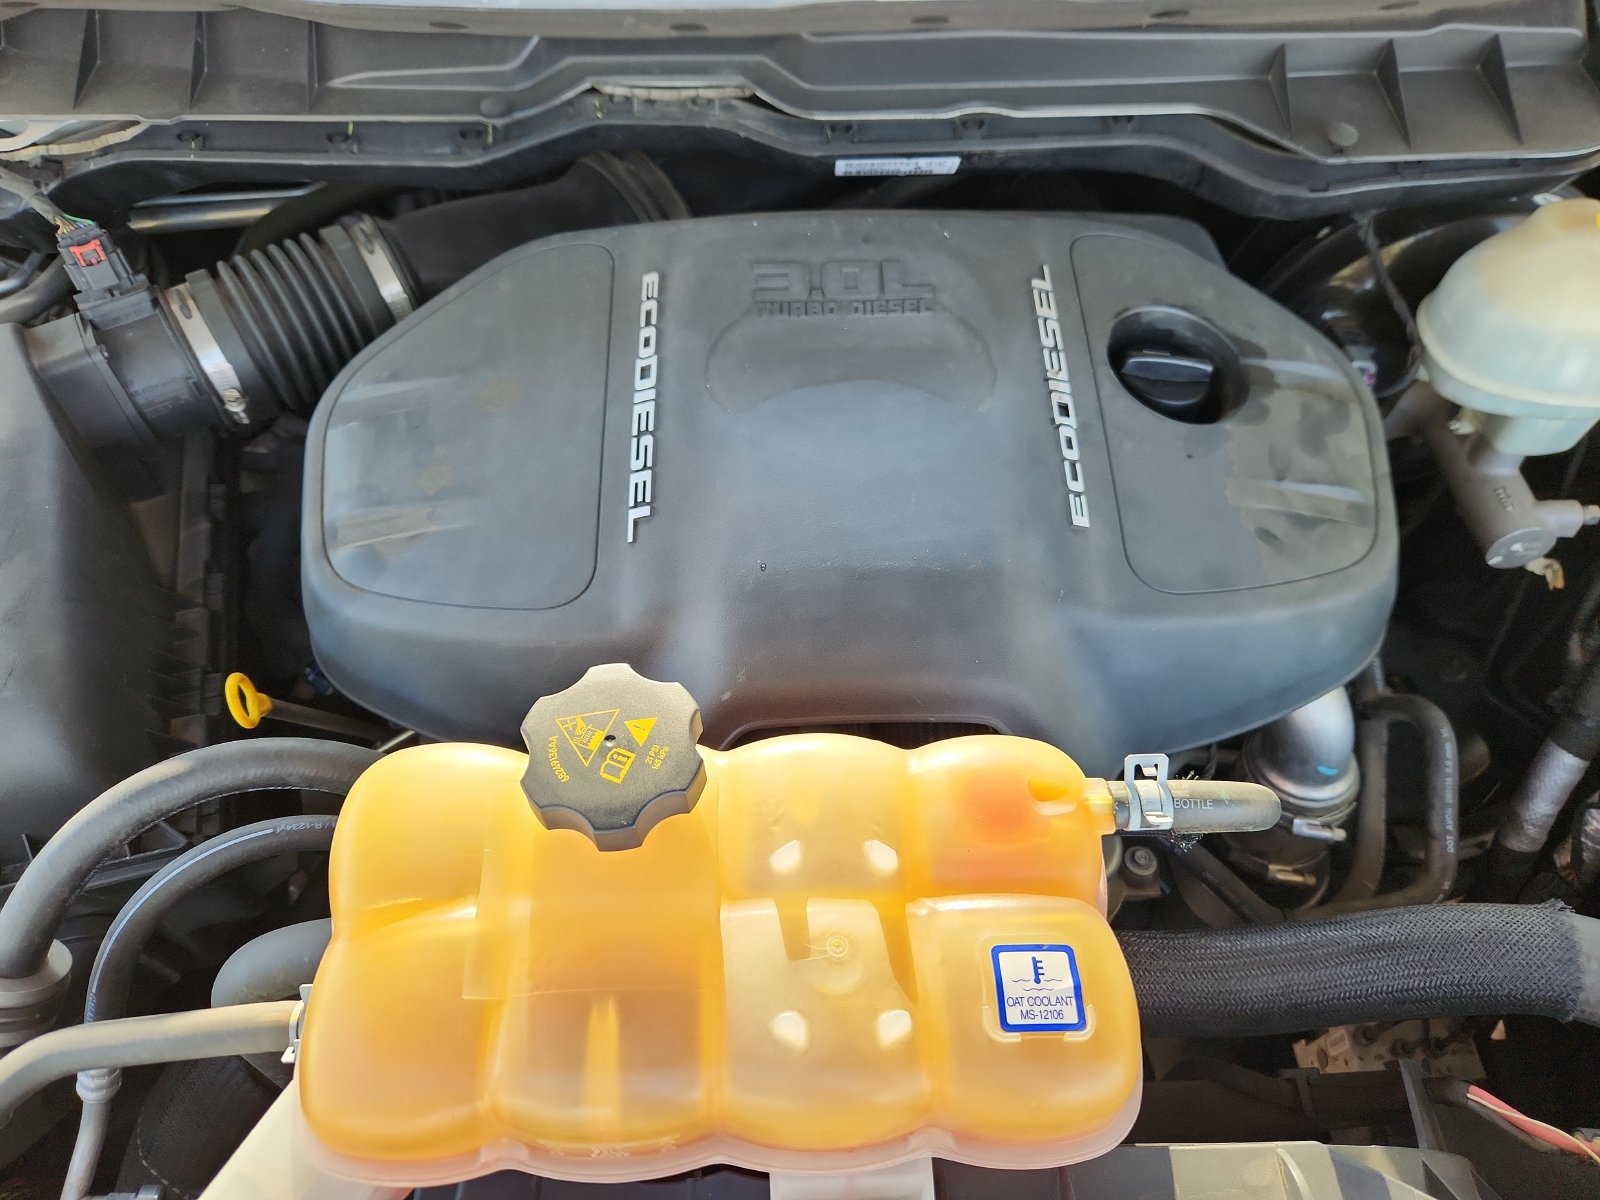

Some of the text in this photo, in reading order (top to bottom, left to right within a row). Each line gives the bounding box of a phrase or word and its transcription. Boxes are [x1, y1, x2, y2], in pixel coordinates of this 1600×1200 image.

[757, 299, 936, 319] TURBO DIESEL
[1031, 263, 1091, 528] ECODIESEL
[626, 271, 660, 543] ECODIESEL
[1174, 798, 1214, 809] BOTTLE
[1006, 995, 1074, 1007] OAT COOLANT
[1020, 1009, 1065, 1020] MS-12106
